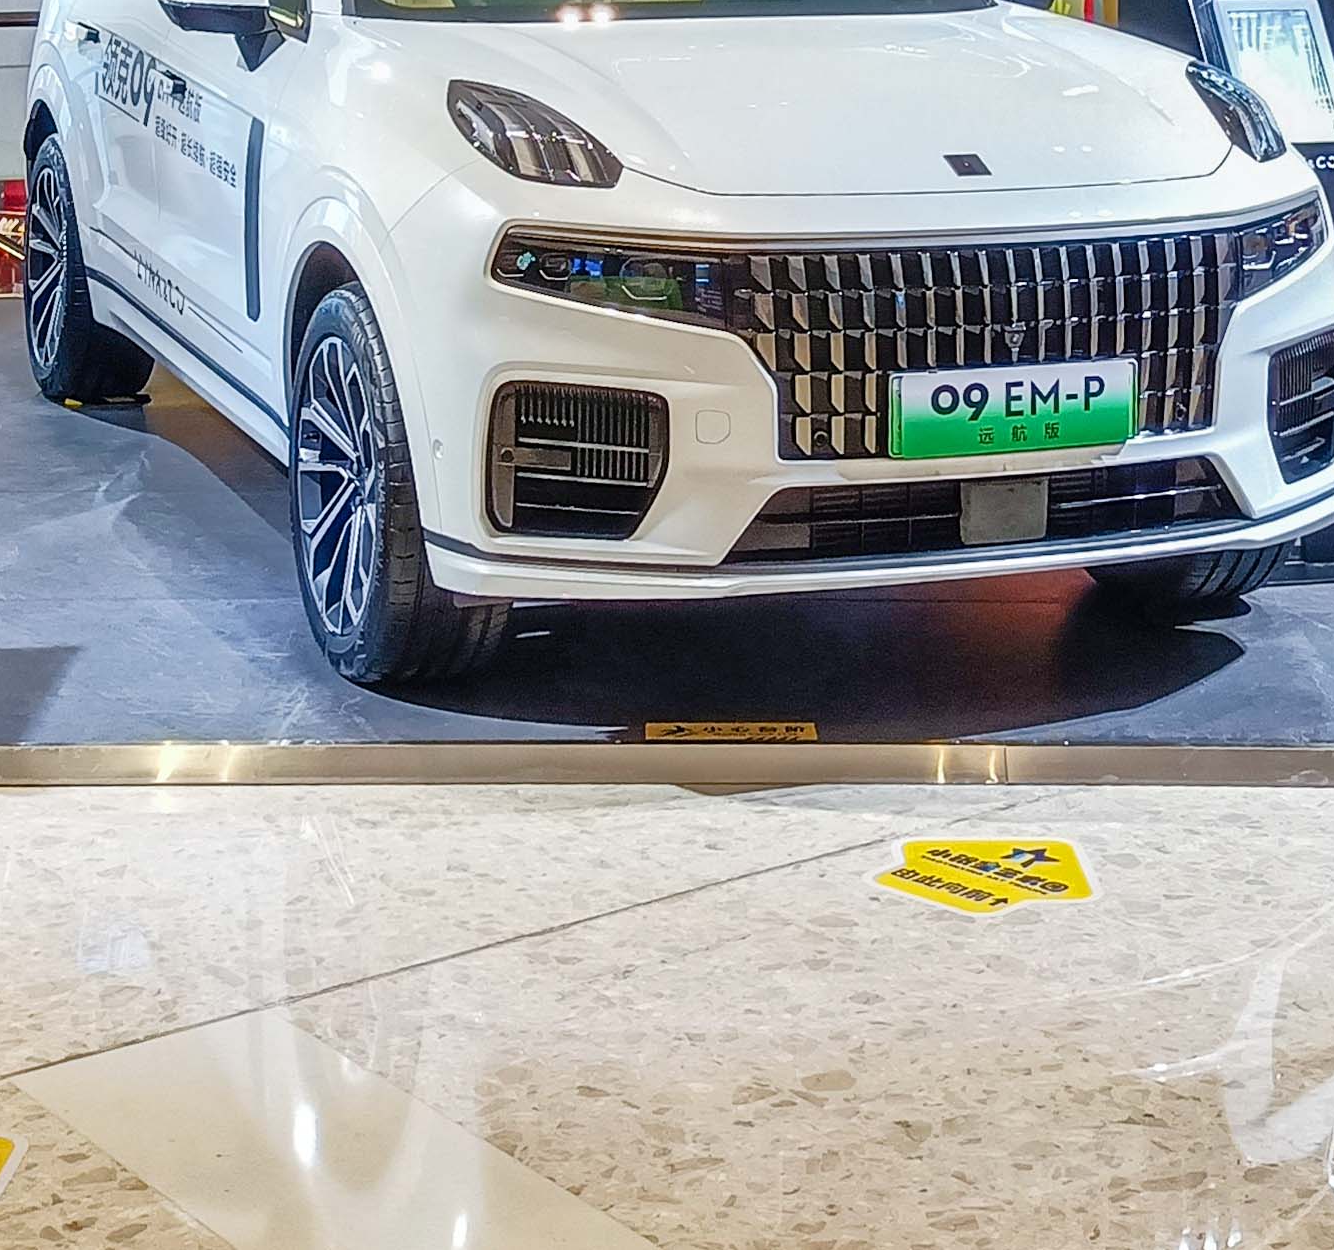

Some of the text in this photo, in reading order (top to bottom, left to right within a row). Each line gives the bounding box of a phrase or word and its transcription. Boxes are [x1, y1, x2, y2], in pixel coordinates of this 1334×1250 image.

[931, 375, 1105, 421] 09 EM-P
[979, 422, 1060, 445] 远航版
